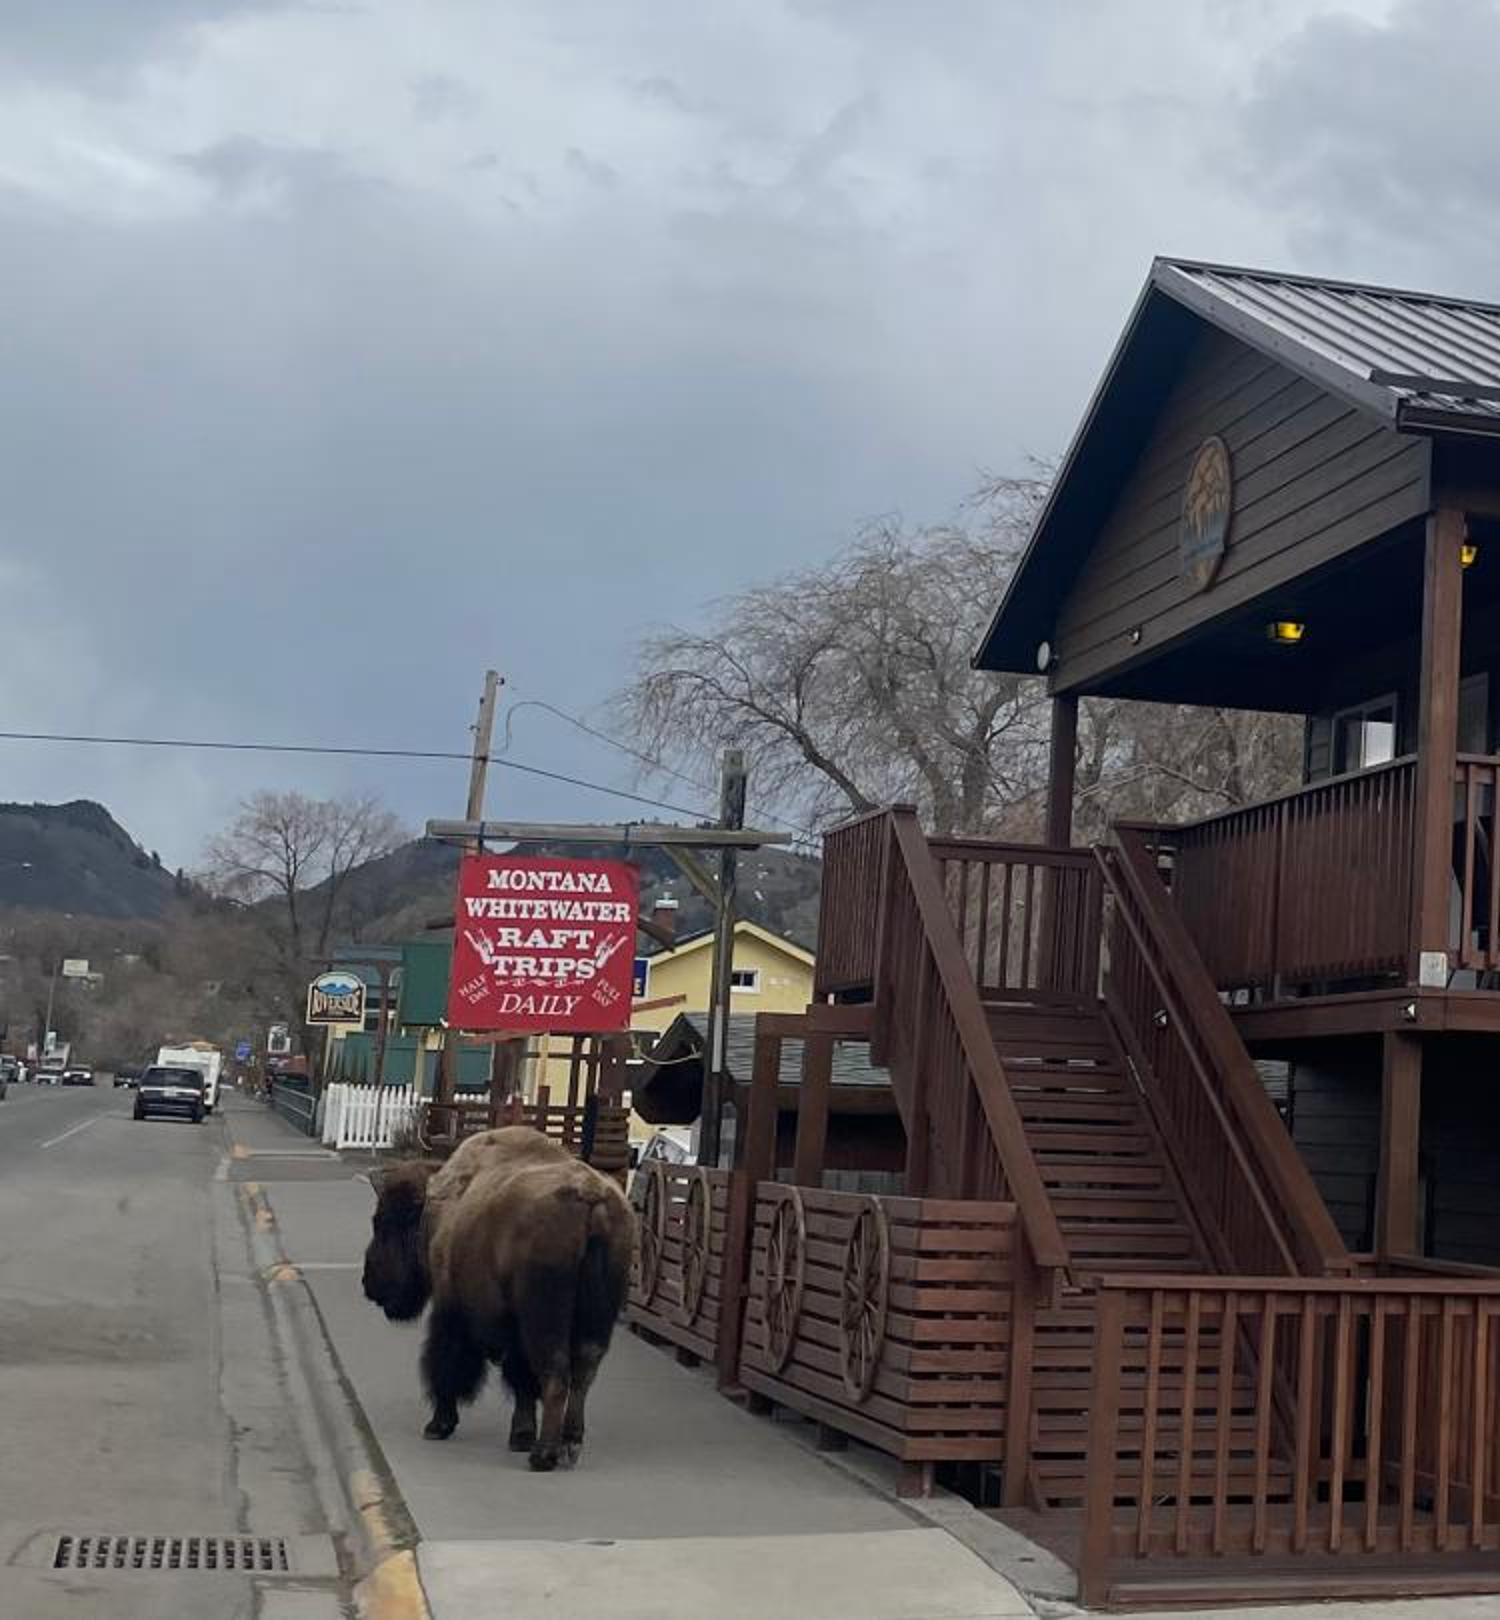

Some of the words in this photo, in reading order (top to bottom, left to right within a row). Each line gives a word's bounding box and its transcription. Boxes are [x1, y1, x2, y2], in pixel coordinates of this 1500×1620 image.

[487, 869, 612, 893] MONTANA
[464, 897, 631, 922] WHITEWATER
[497, 928, 595, 949] RAFT
[493, 956, 596, 979] TRIPS
[458, 974, 488, 997] HALF
[468, 986, 491, 1005] DAY
[597, 978, 621, 1000] FULL
[499, 993, 583, 1016] DAILY
[592, 991, 611, 1008] DAY
